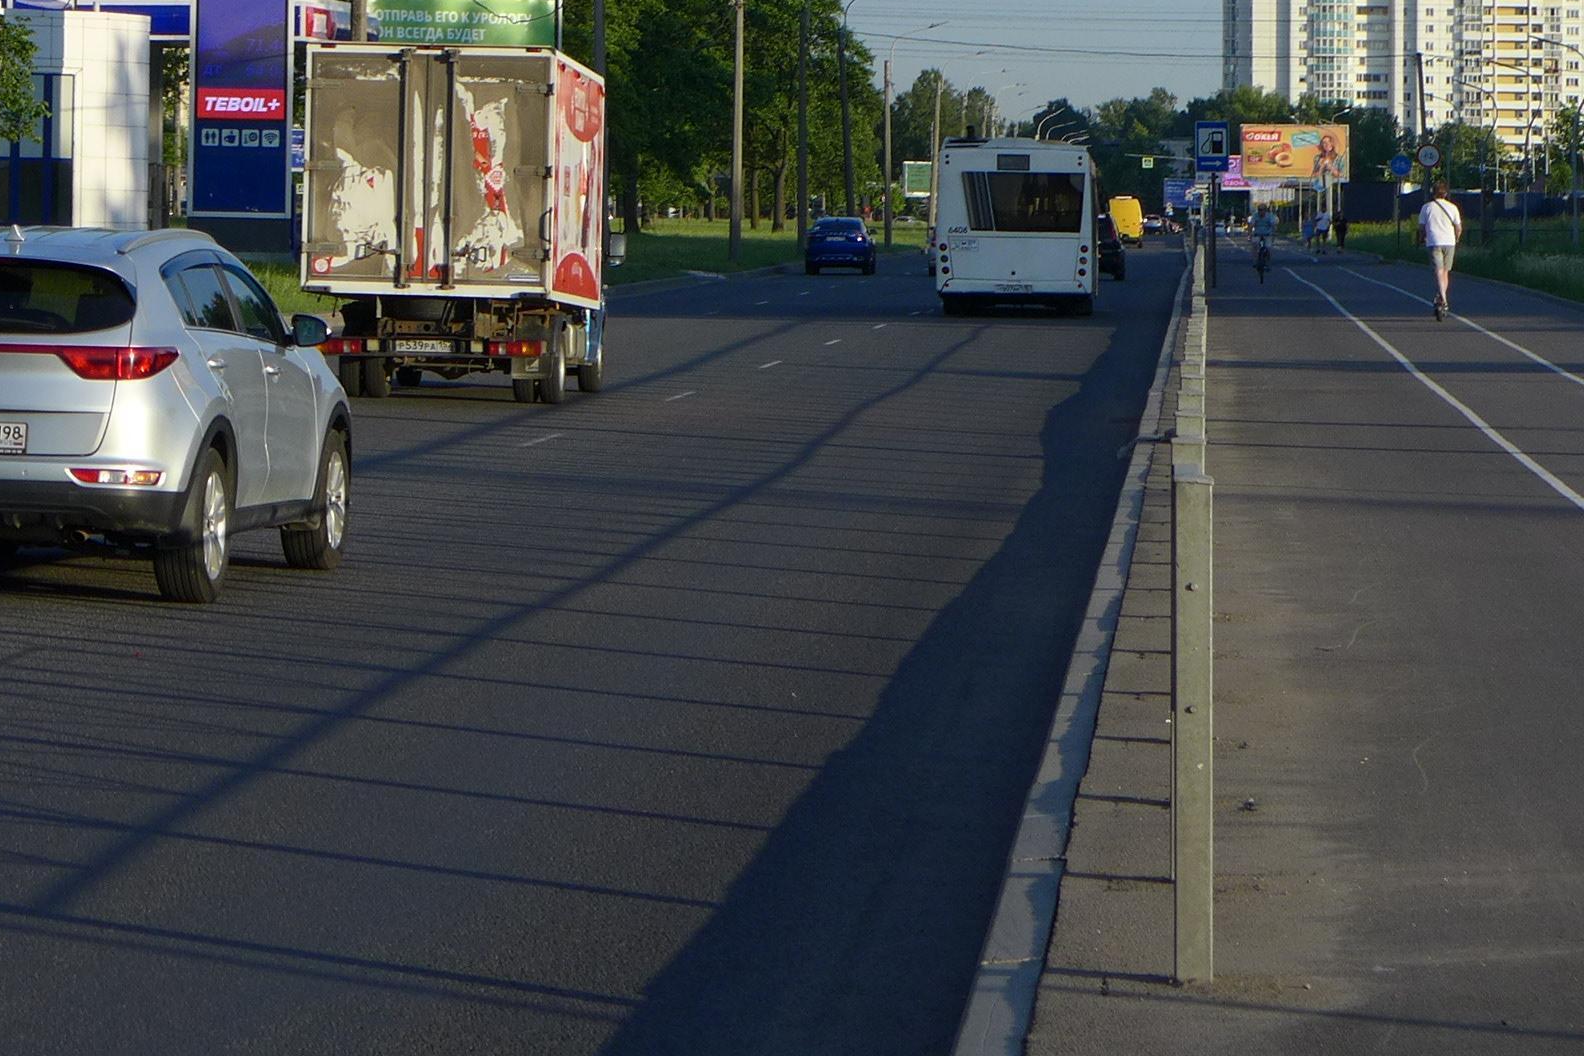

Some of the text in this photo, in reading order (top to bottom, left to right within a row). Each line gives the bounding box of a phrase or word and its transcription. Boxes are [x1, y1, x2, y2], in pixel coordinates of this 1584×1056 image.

[376, 10, 532, 26] ОТПРАВЬ ЕГО К УРОЛОГУ
[397, 27, 444, 41] ВСЕГДА
[447, 27, 485, 41] БУДЕТ
